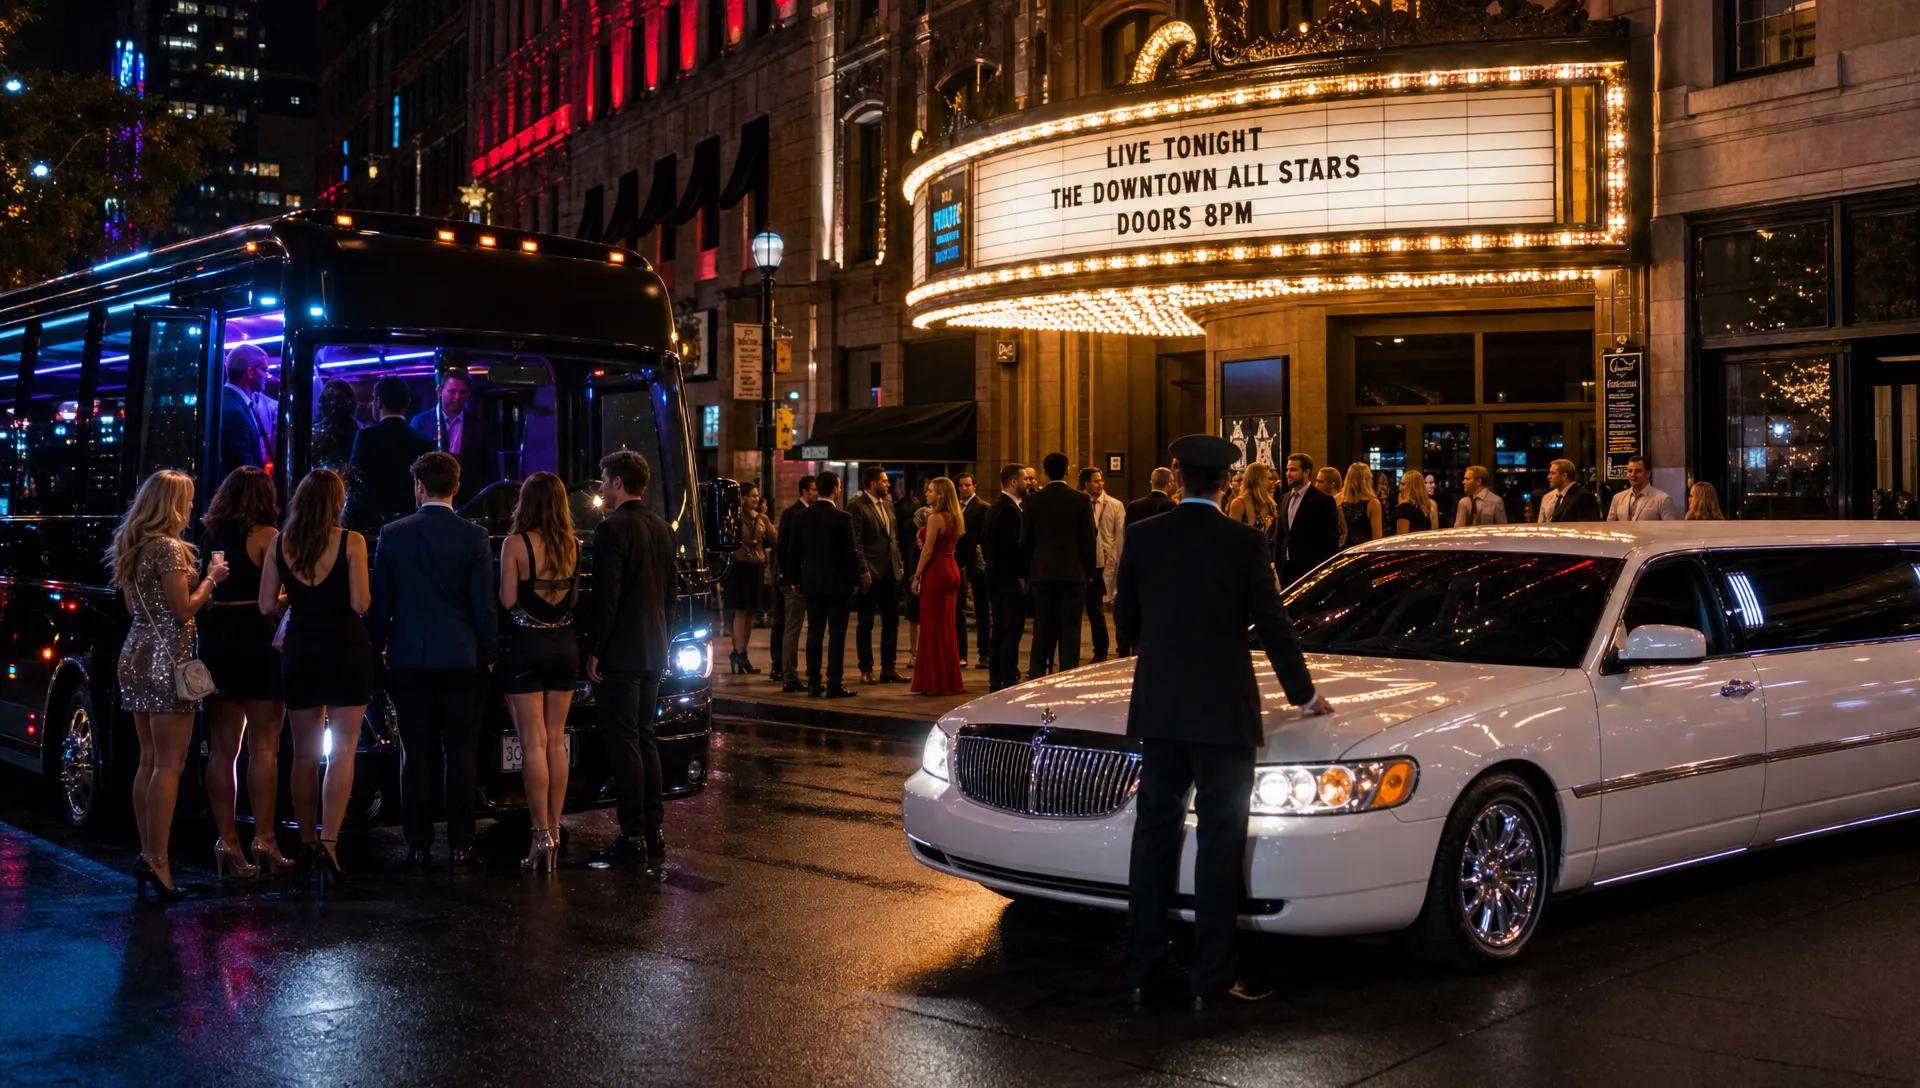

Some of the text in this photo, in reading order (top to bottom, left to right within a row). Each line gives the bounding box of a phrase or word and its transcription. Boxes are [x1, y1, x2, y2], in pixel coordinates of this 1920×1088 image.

[1106, 127, 1262, 168] LIVE TONIGHT
[1051, 154, 1360, 209] THE DOWNTOWN ALL STARS
[1117, 201, 1253, 235] DOORS 8PM
